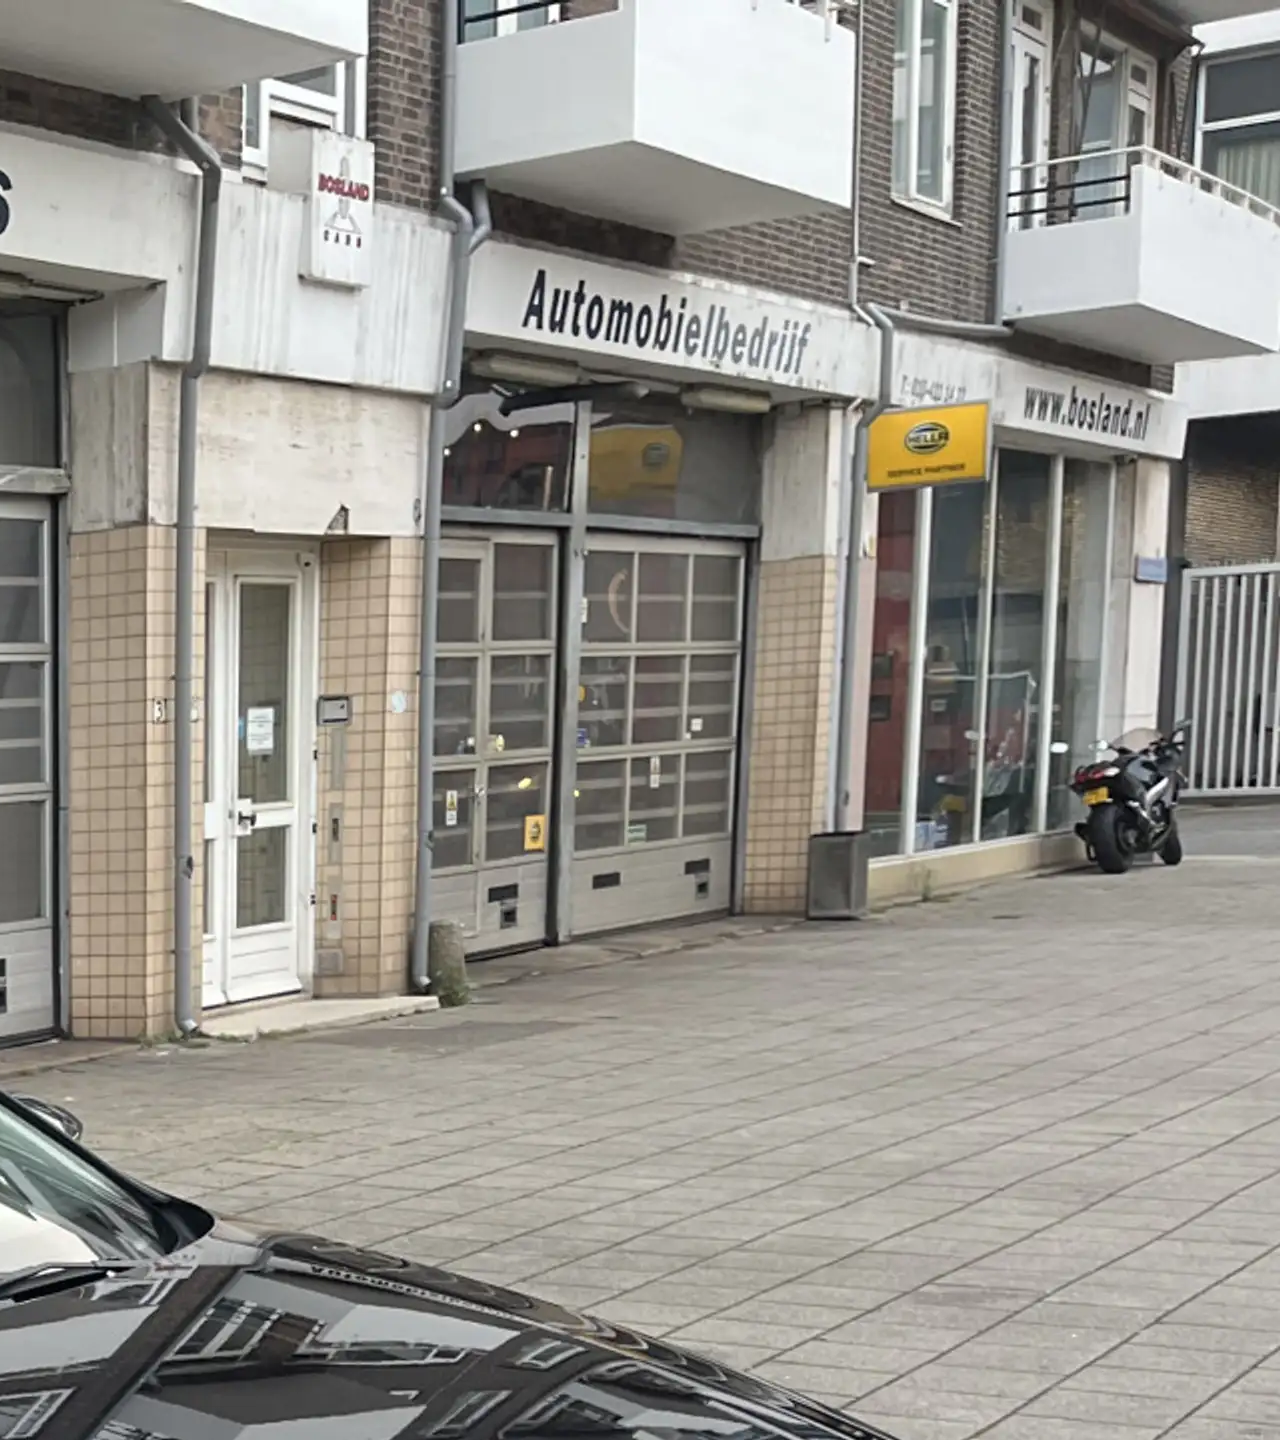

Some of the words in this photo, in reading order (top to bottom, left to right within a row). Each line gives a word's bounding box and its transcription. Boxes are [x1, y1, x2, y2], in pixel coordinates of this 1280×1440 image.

[318, 172, 370, 202] BOSLAND
[522, 270, 811, 375] Automobielbedrijf
[1024, 385, 1151, 441] www.bosland.nl
